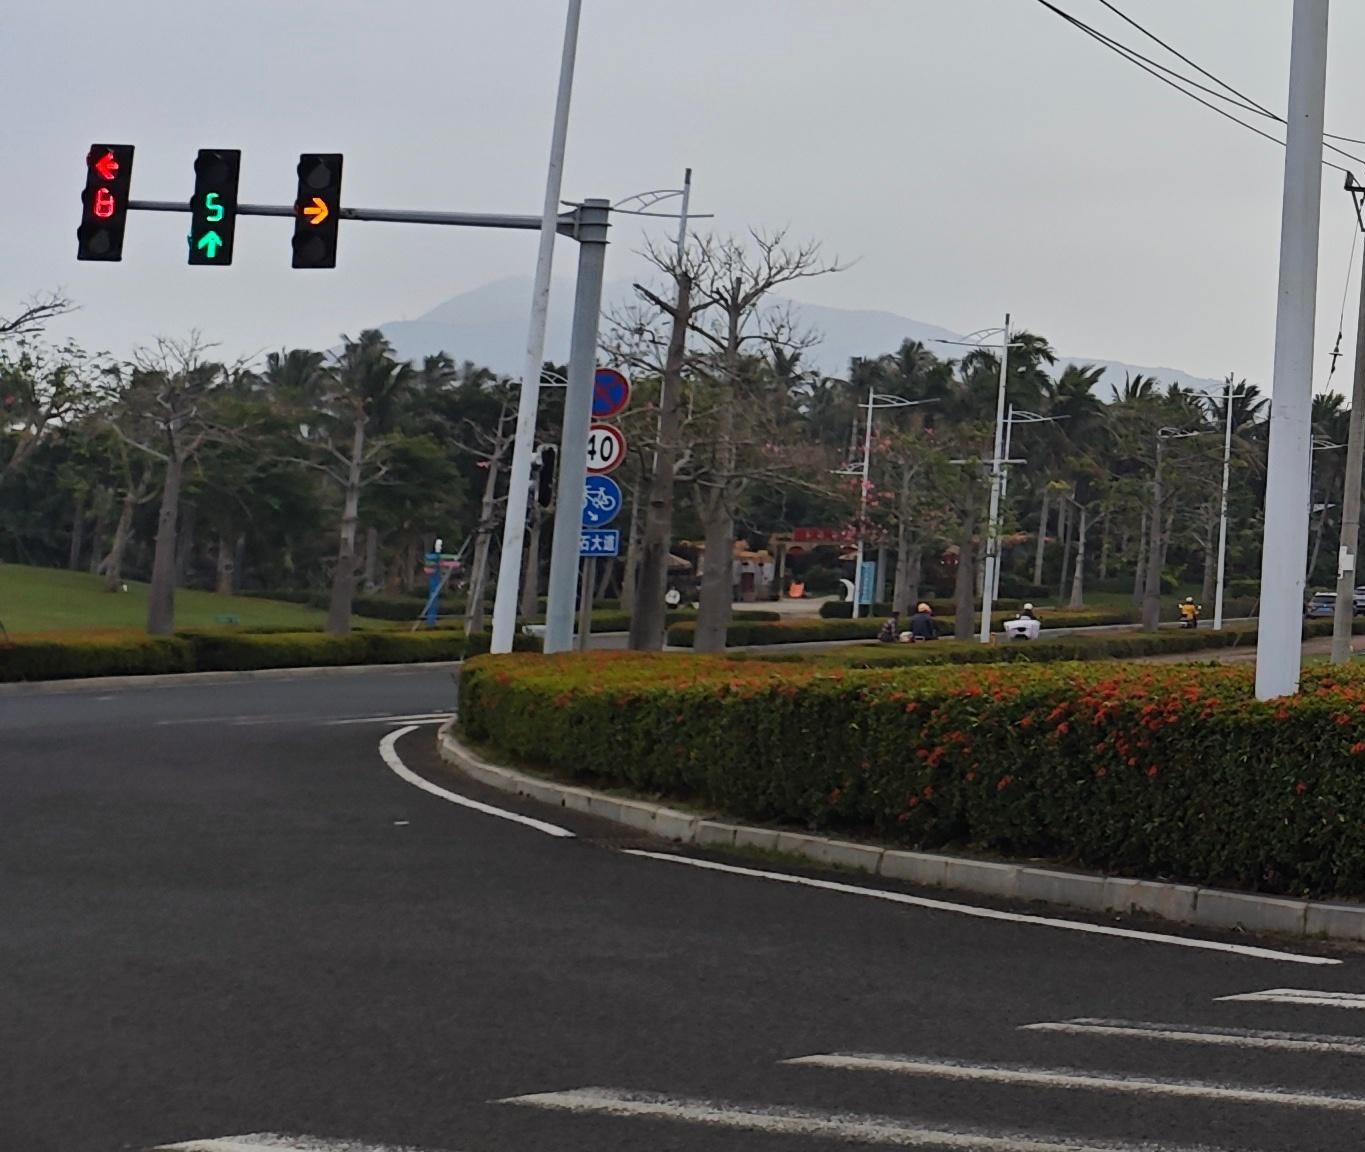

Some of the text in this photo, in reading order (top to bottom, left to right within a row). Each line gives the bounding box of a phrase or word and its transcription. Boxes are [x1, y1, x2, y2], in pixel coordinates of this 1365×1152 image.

[205, 192, 224, 222] 5
[588, 434, 613, 462] 40
[580, 534, 616, 552] 石大道
